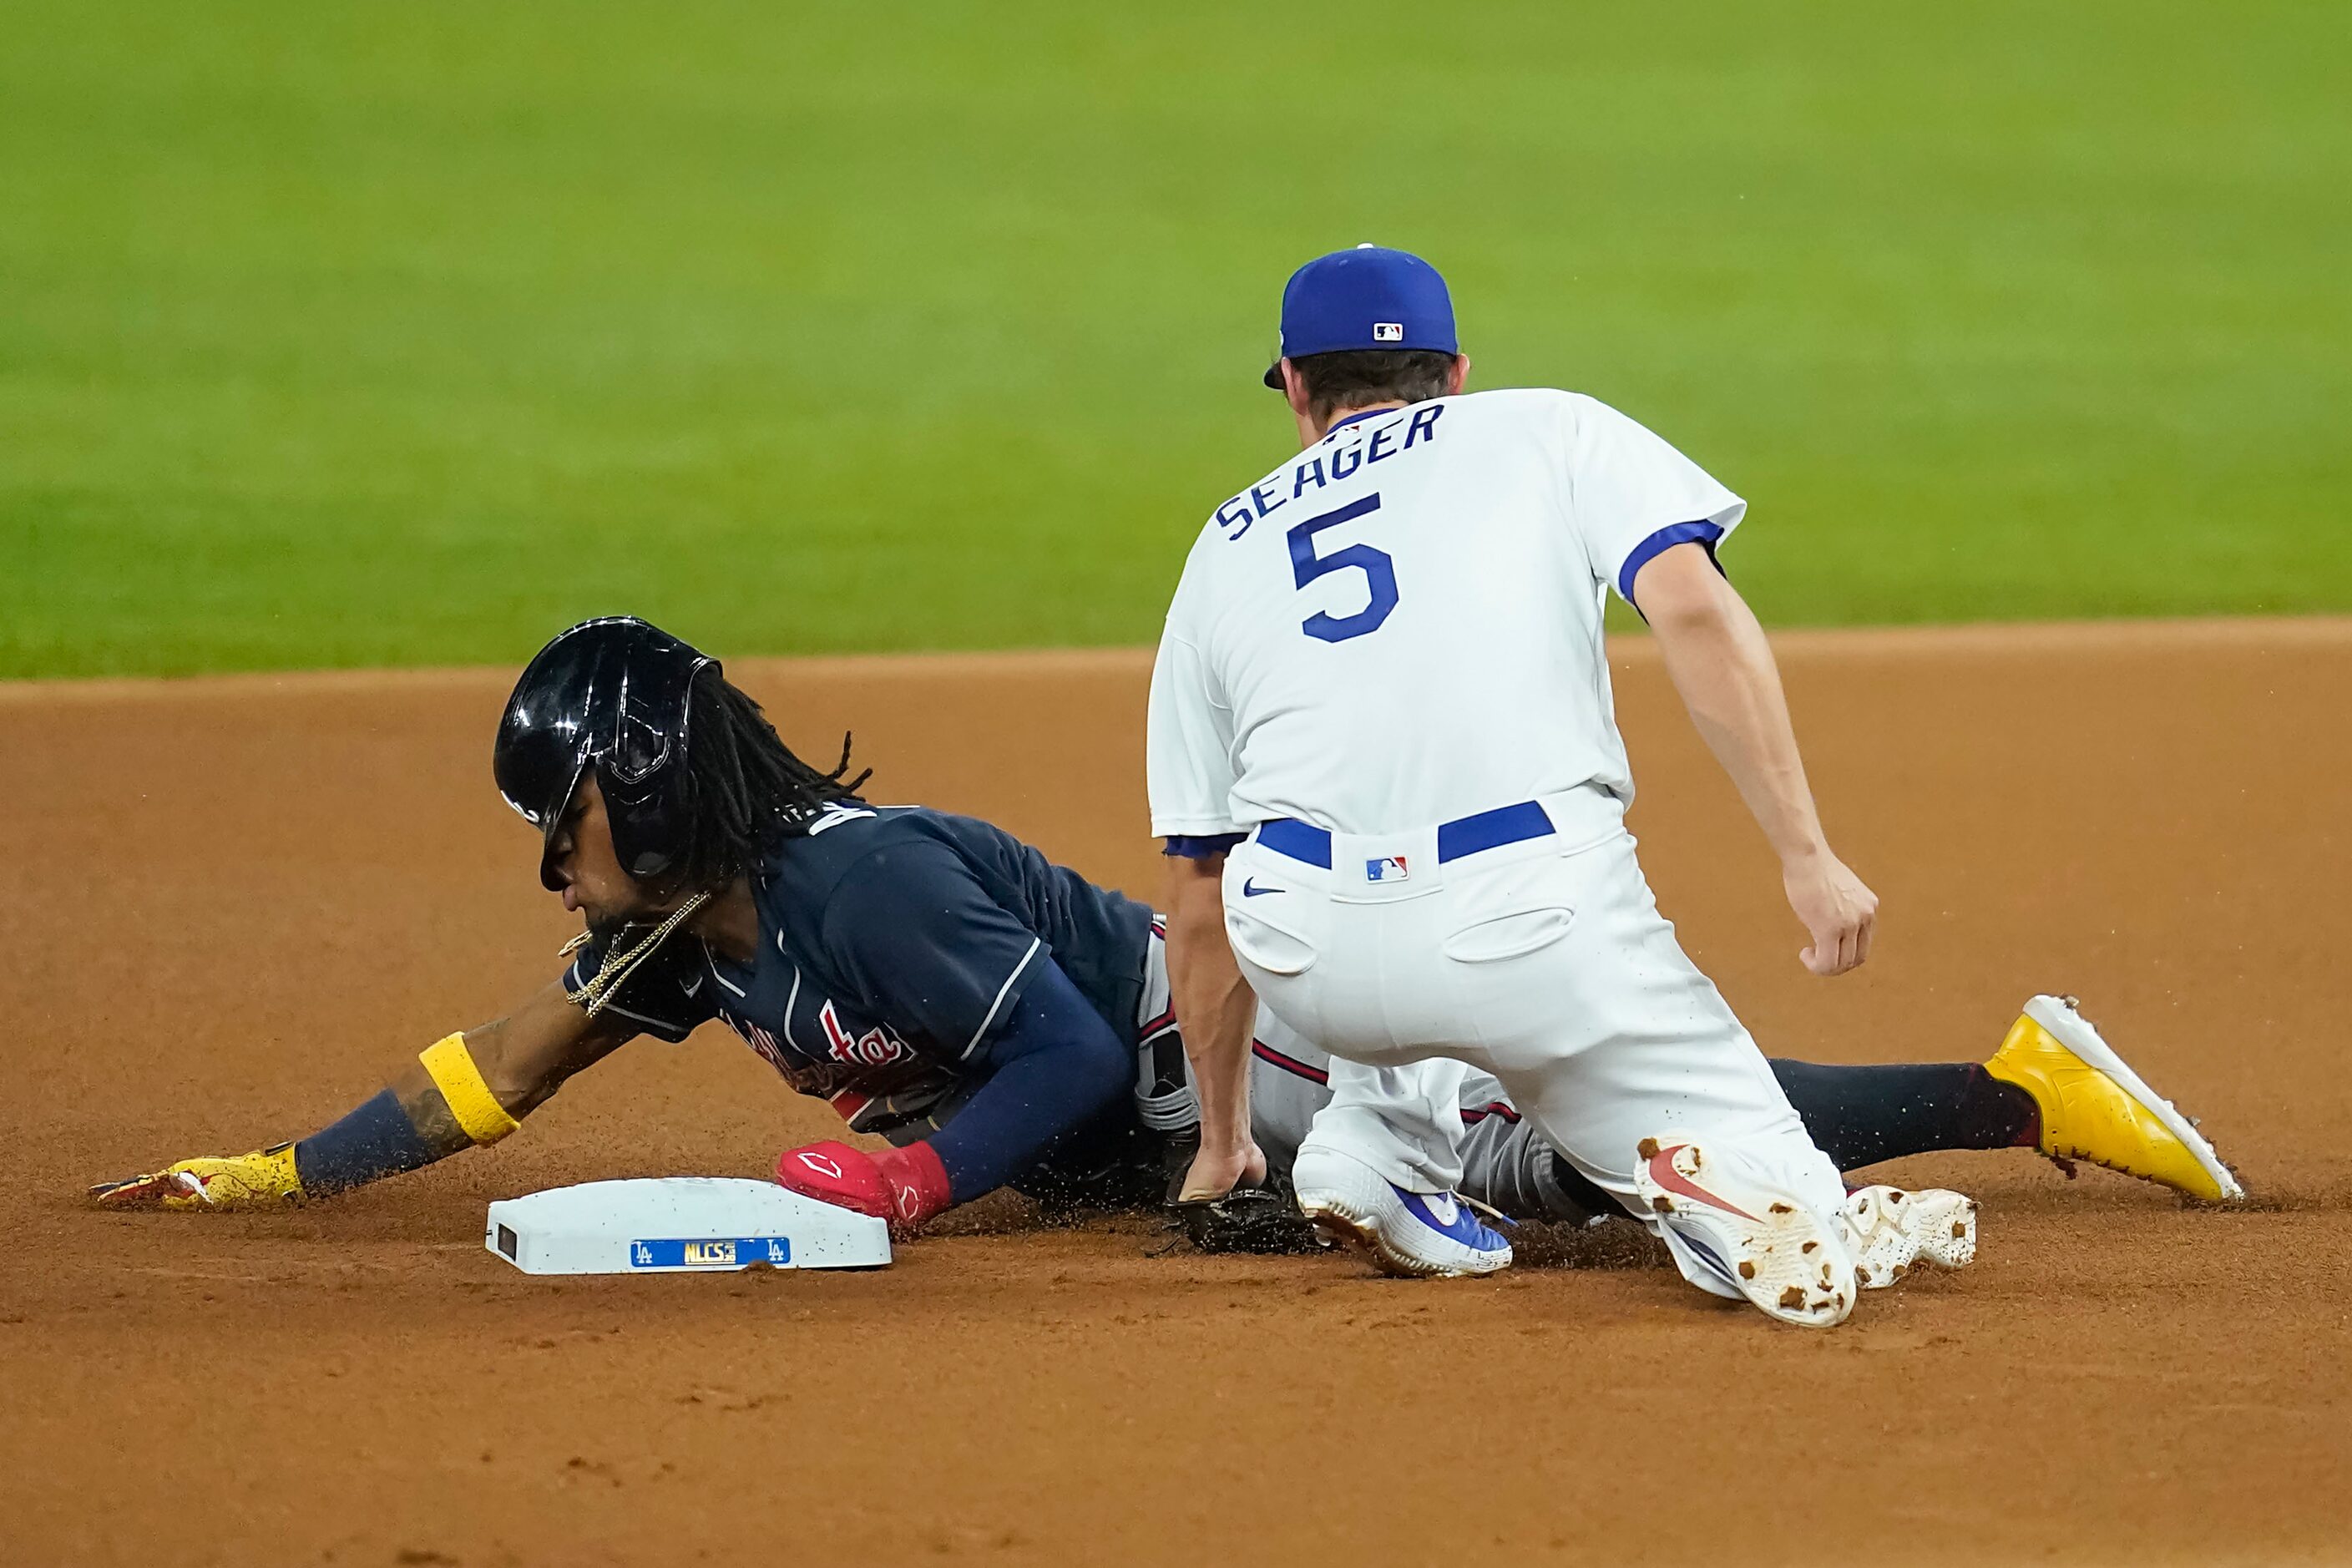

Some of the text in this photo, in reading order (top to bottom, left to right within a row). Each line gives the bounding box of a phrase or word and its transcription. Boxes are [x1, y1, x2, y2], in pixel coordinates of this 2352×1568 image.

[1216, 405, 1444, 541] SEAGER
[1287, 492, 1399, 642] 5
[636, 1242, 652, 1263] LA
[685, 1242, 724, 1262] NLCS
[767, 1239, 783, 1261] LA
